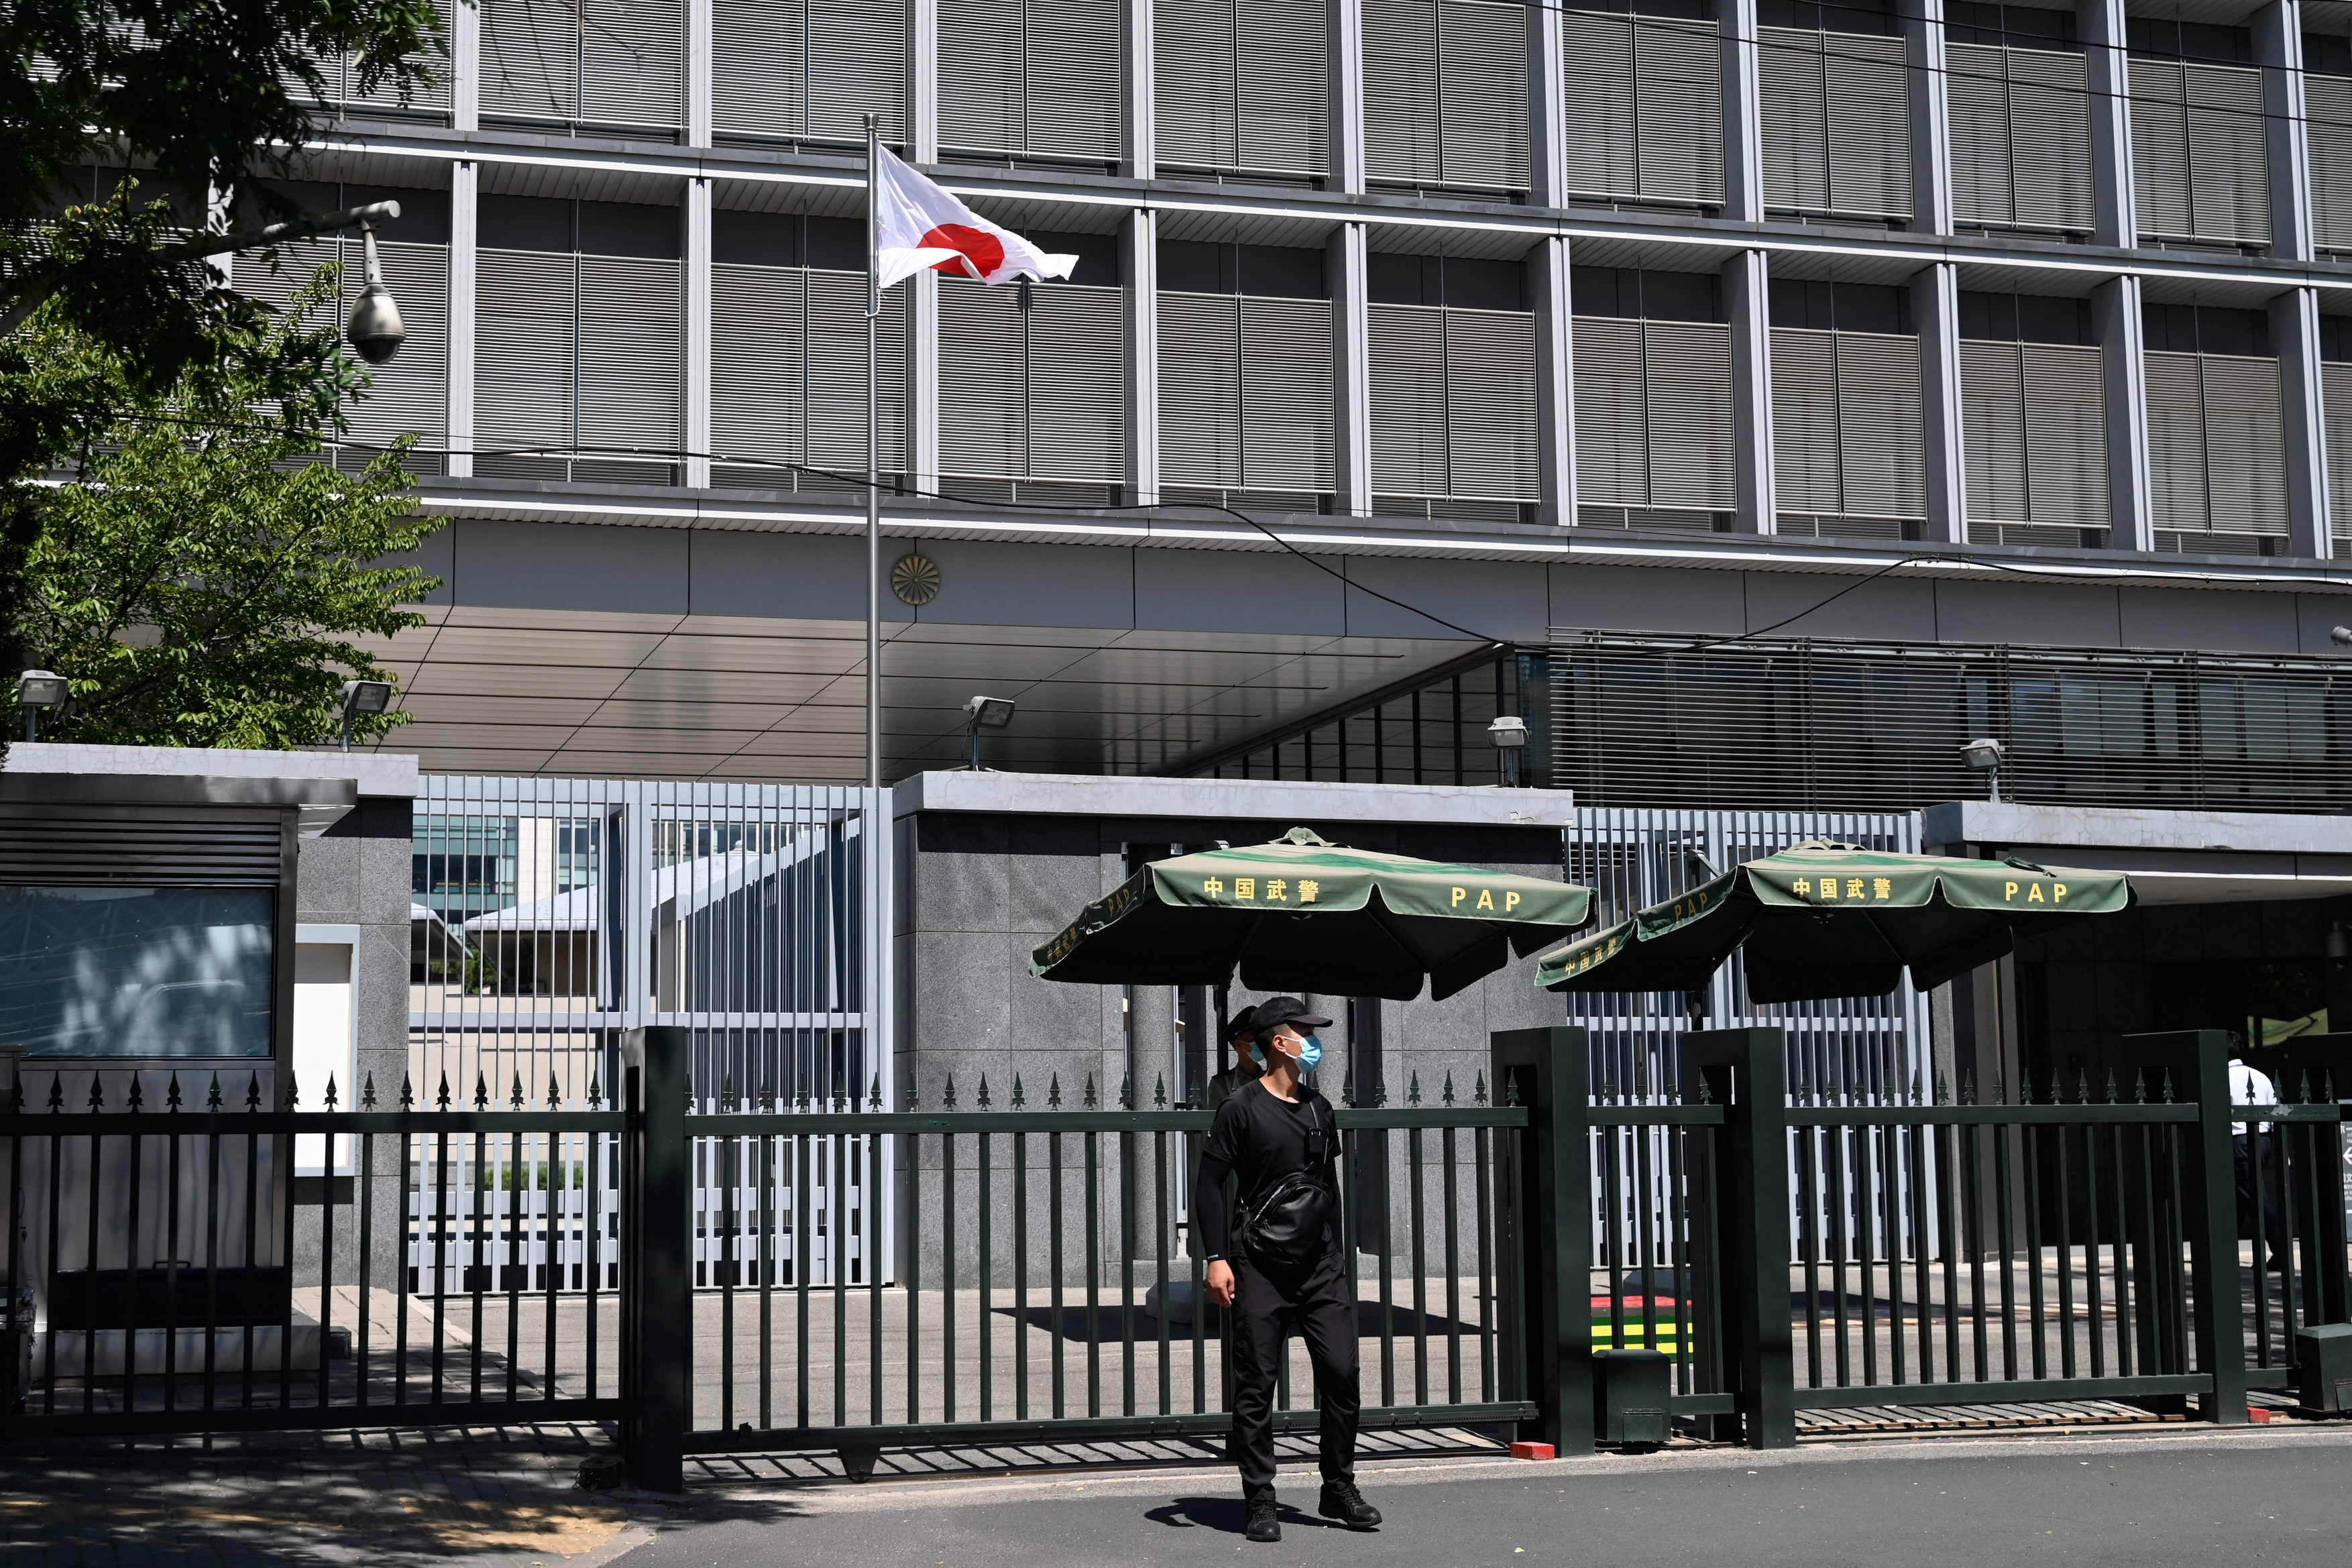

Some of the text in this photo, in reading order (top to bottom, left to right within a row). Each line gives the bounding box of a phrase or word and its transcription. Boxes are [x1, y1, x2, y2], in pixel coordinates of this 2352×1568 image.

[1203, 876, 1319, 903] 中国武警
[1451, 887, 1521, 912] PAP
[1793, 877, 1891, 899] 中国武警
[2005, 881, 2068, 903] PAP
[1107, 888, 1131, 917] PAP
[1674, 892, 1708, 922] PAP
[1565, 936, 1618, 976] 中国武警
